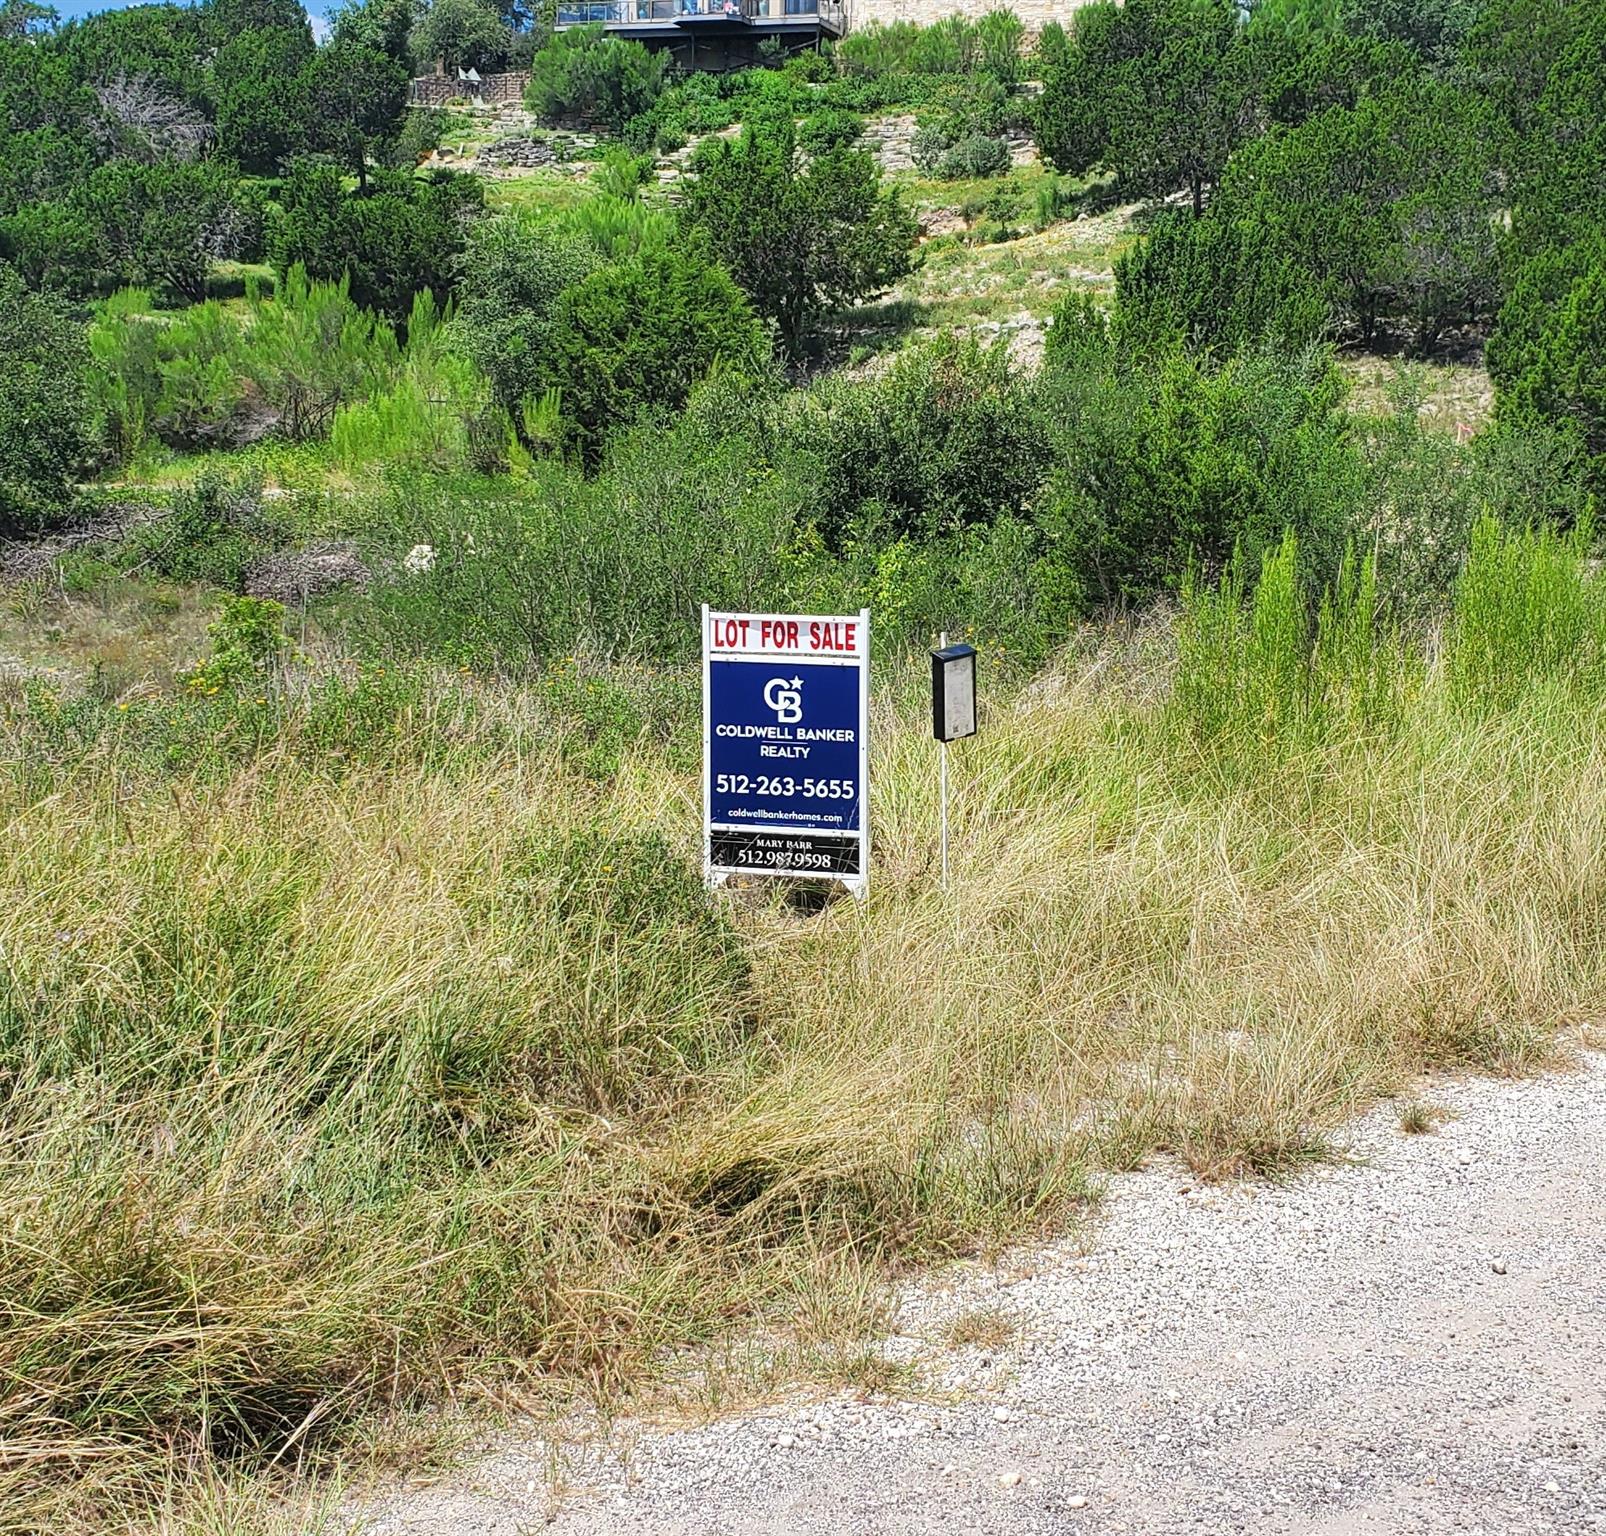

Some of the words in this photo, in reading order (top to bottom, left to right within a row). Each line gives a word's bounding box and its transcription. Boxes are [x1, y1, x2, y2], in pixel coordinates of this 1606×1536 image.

[715, 619, 750, 648] LOT
[761, 620, 799, 649] FOR
[810, 622, 856, 651] SALE
[716, 724, 793, 741] COLDWELL
[796, 727, 855, 743] BANKER
[760, 745, 810, 759] REALTY
[716, 774, 855, 800] 512-263-5655
[728, 808, 843, 823] coldwellbankerhomes.com
[756, 838, 784, 849] MARY
[786, 839, 813, 850] BARR
[738, 849, 832, 869] 512.987.9598
